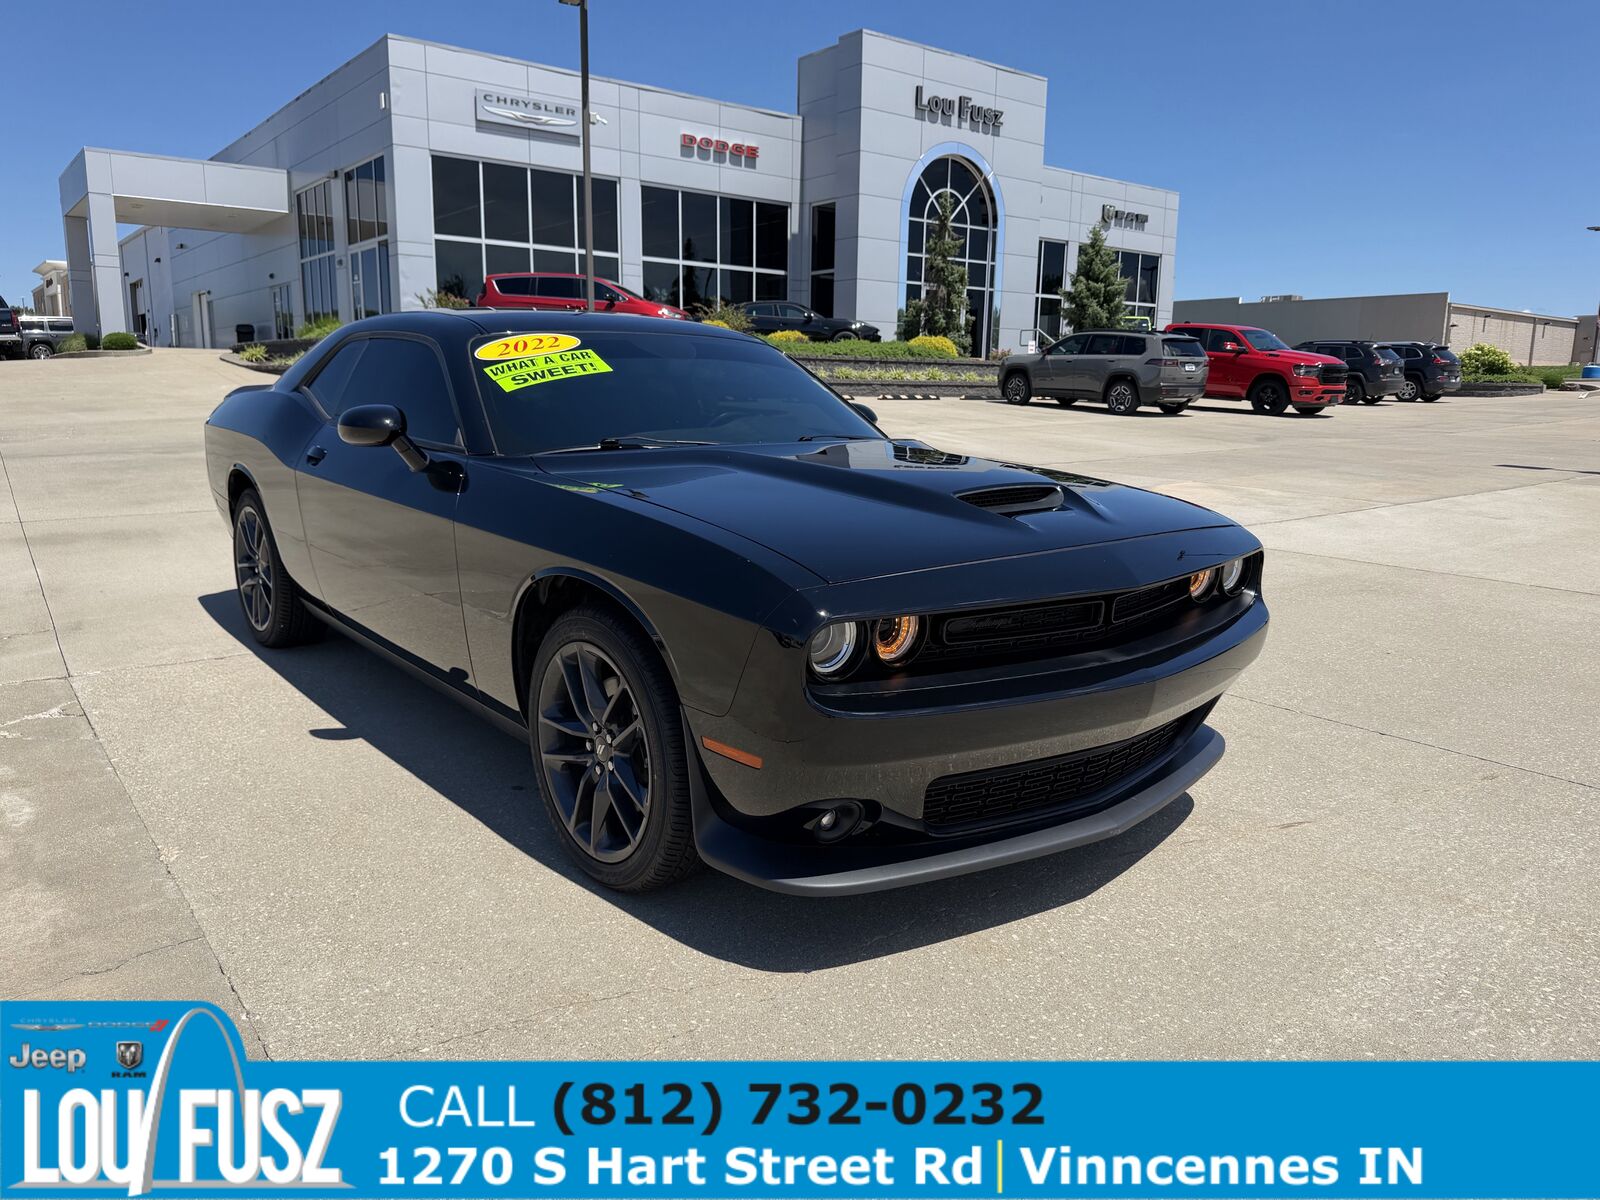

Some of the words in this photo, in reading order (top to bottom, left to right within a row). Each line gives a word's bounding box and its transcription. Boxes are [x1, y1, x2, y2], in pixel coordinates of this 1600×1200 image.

[483, 93, 576, 116] CHRYSLER
[915, 85, 955, 115] Lou
[958, 95, 1005, 125] Fusz
[680, 133, 759, 158] DODGE
[498, 336, 561, 357] 2022
[490, 358, 538, 376] WHAT
[544, 356, 556, 365] A
[560, 351, 592, 362] CAR
[511, 362, 598, 386] SWEET!
